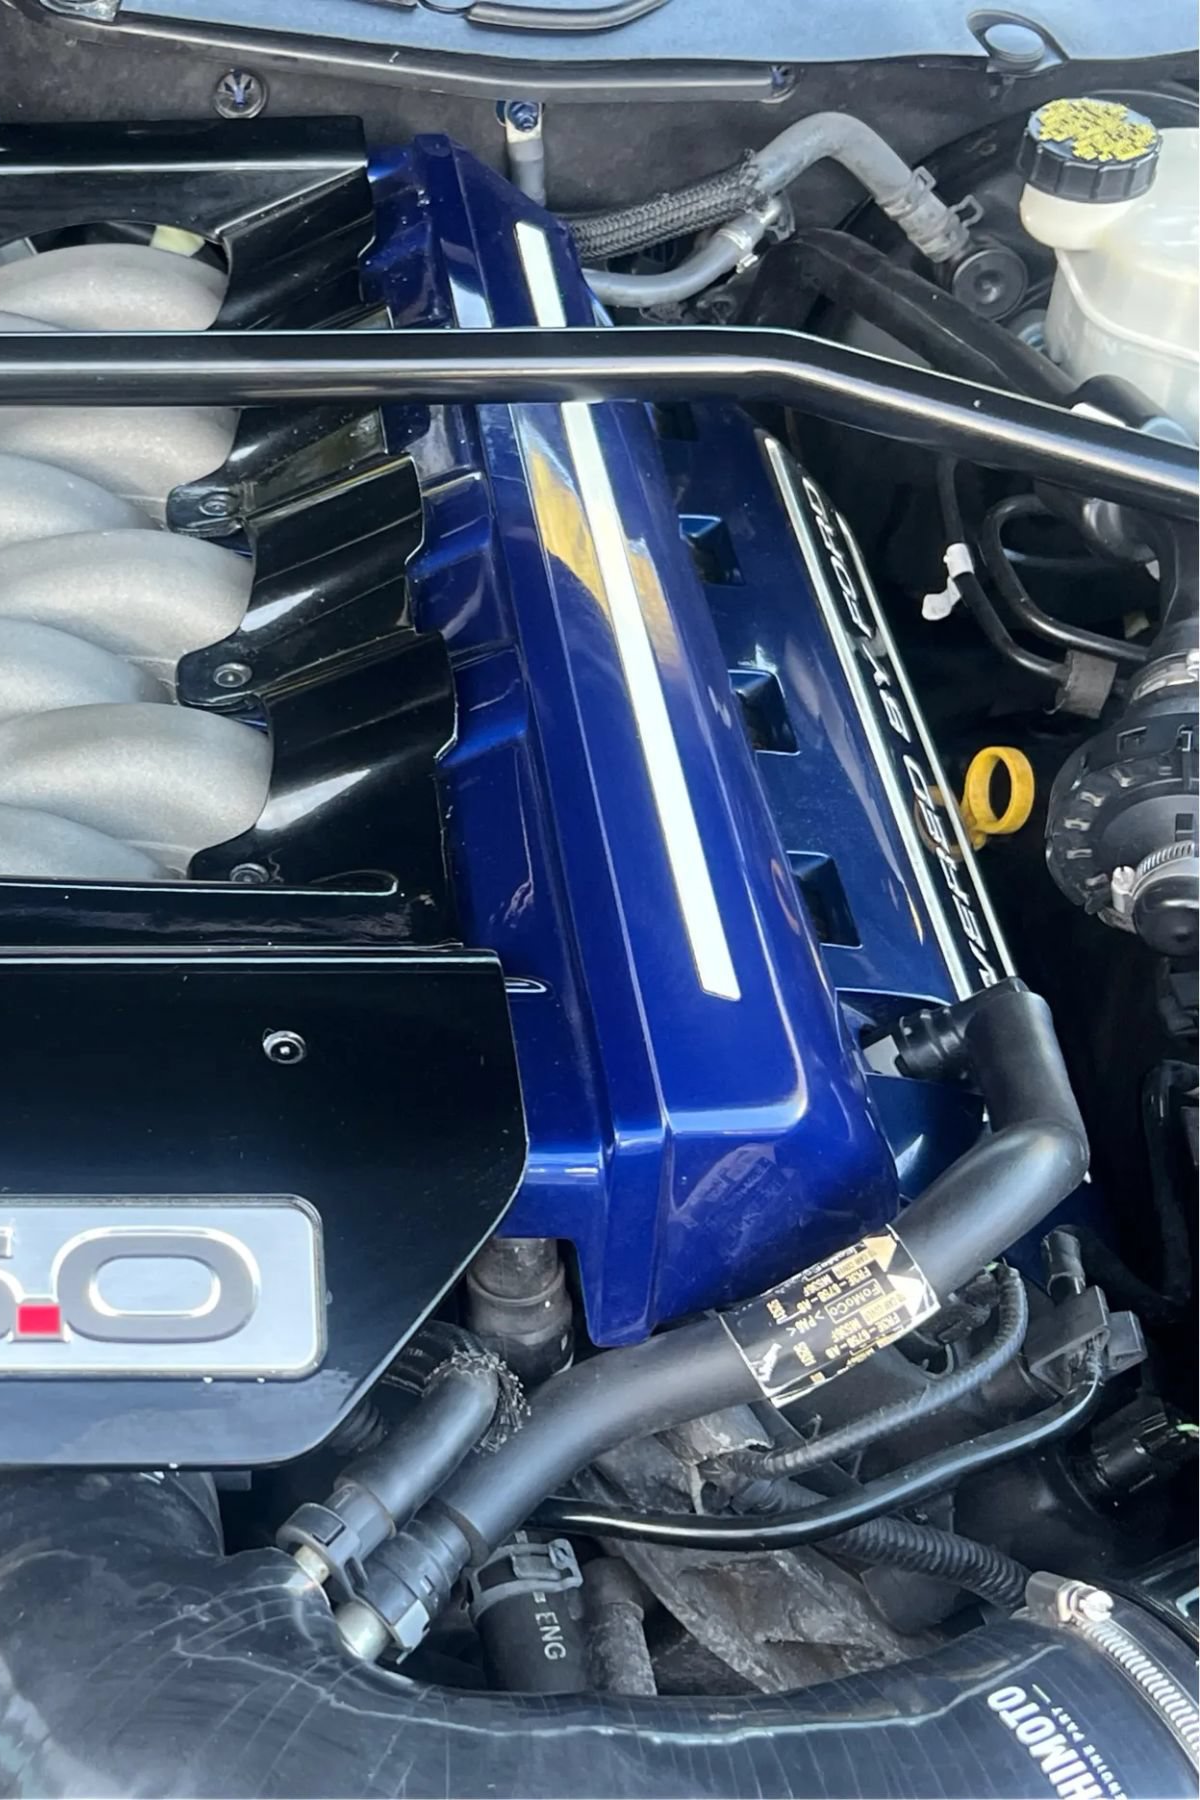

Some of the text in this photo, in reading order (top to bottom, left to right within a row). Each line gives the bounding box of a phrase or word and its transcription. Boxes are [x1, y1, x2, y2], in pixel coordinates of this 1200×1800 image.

[803, 476, 872, 638] FORD
[861, 642, 911, 743] BY
[829, 1283, 881, 1318] FoMoCo
[535, 1612, 566, 1659] ENG
[1051, 1707, 1085, 1743] PART
